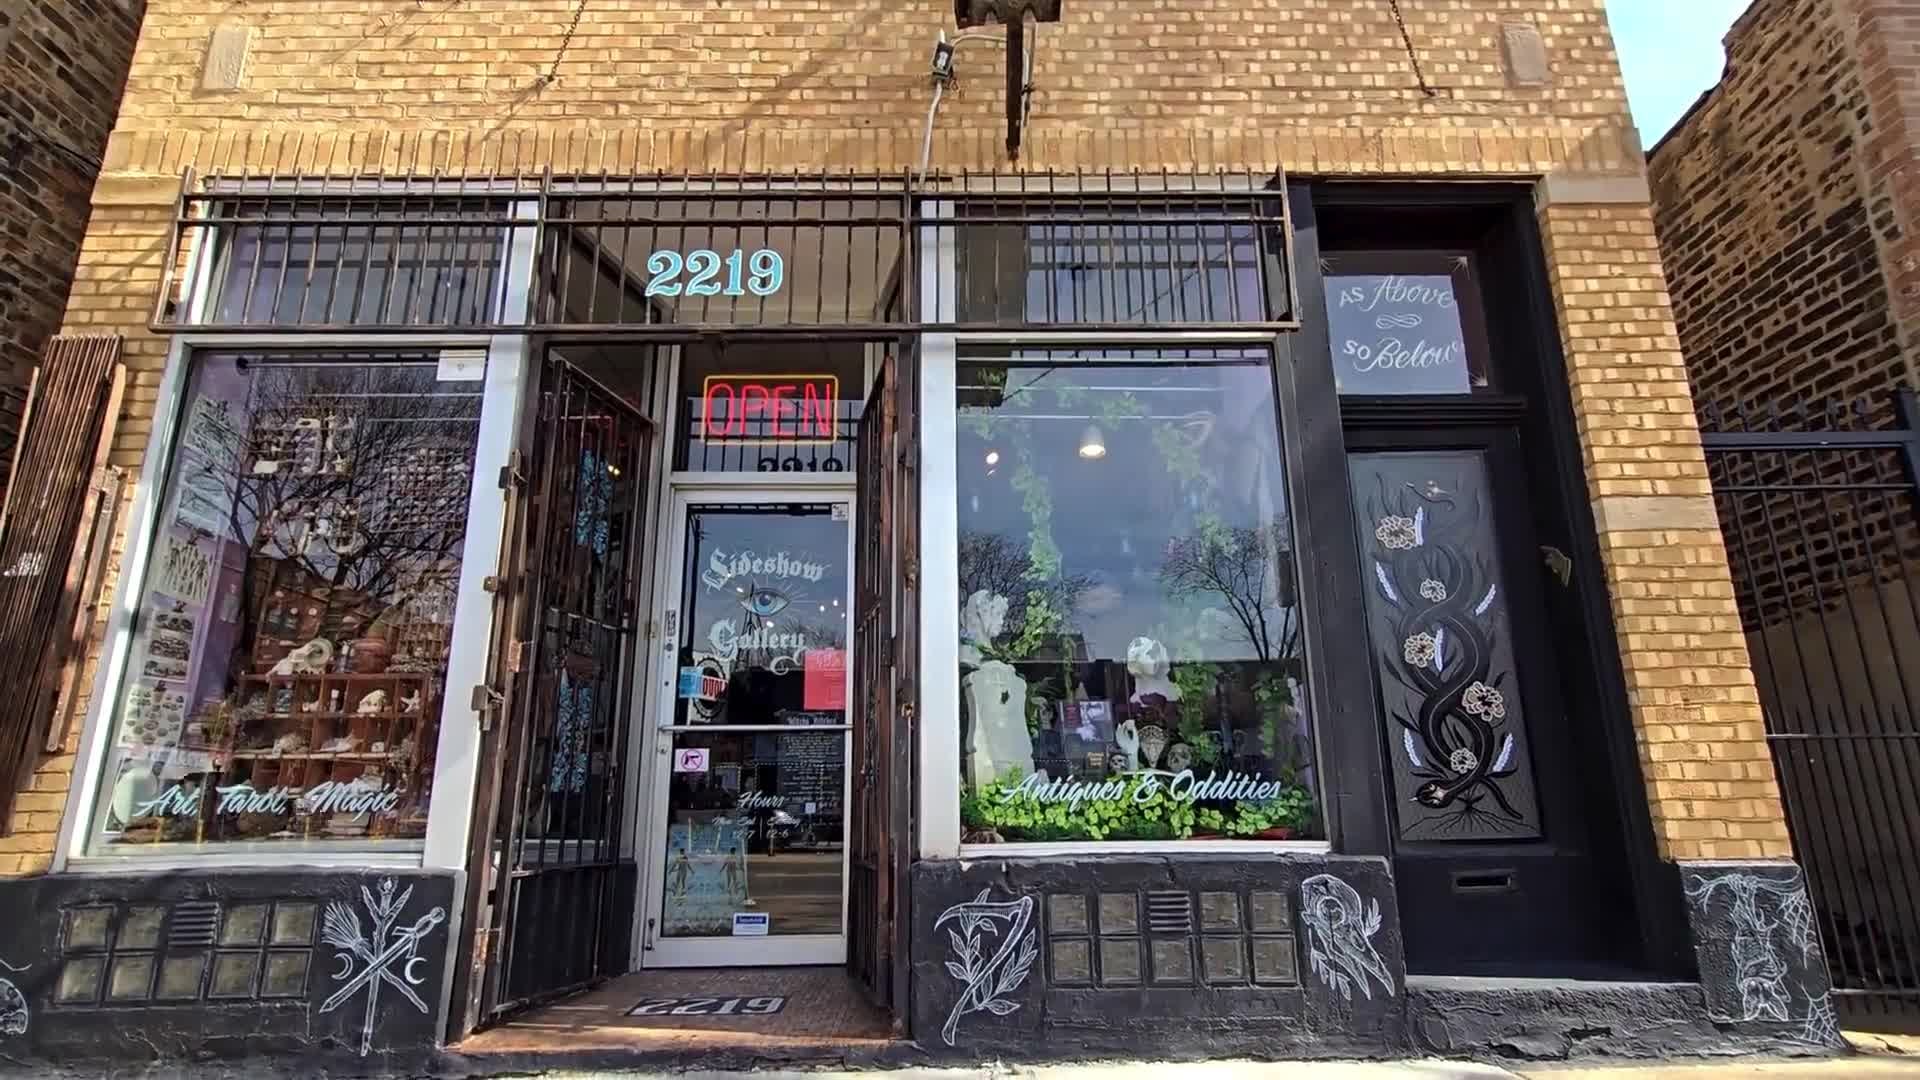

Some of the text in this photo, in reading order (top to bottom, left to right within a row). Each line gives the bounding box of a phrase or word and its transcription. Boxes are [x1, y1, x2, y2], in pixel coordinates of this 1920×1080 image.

[645, 248, 784, 297] 2219
[1339, 275, 1457, 312] AS Above
[1353, 337, 1459, 372] Below
[707, 383, 831, 436] OPEN
[702, 548, 832, 594] Sideshow
[707, 618, 810, 675] Gallery
[303, 781, 400, 822] Magic
[738, 789, 787, 808] Hours
[1000, 770, 1281, 813] Antiques & Oddities
[630, 997, 785, 1016] 2219
